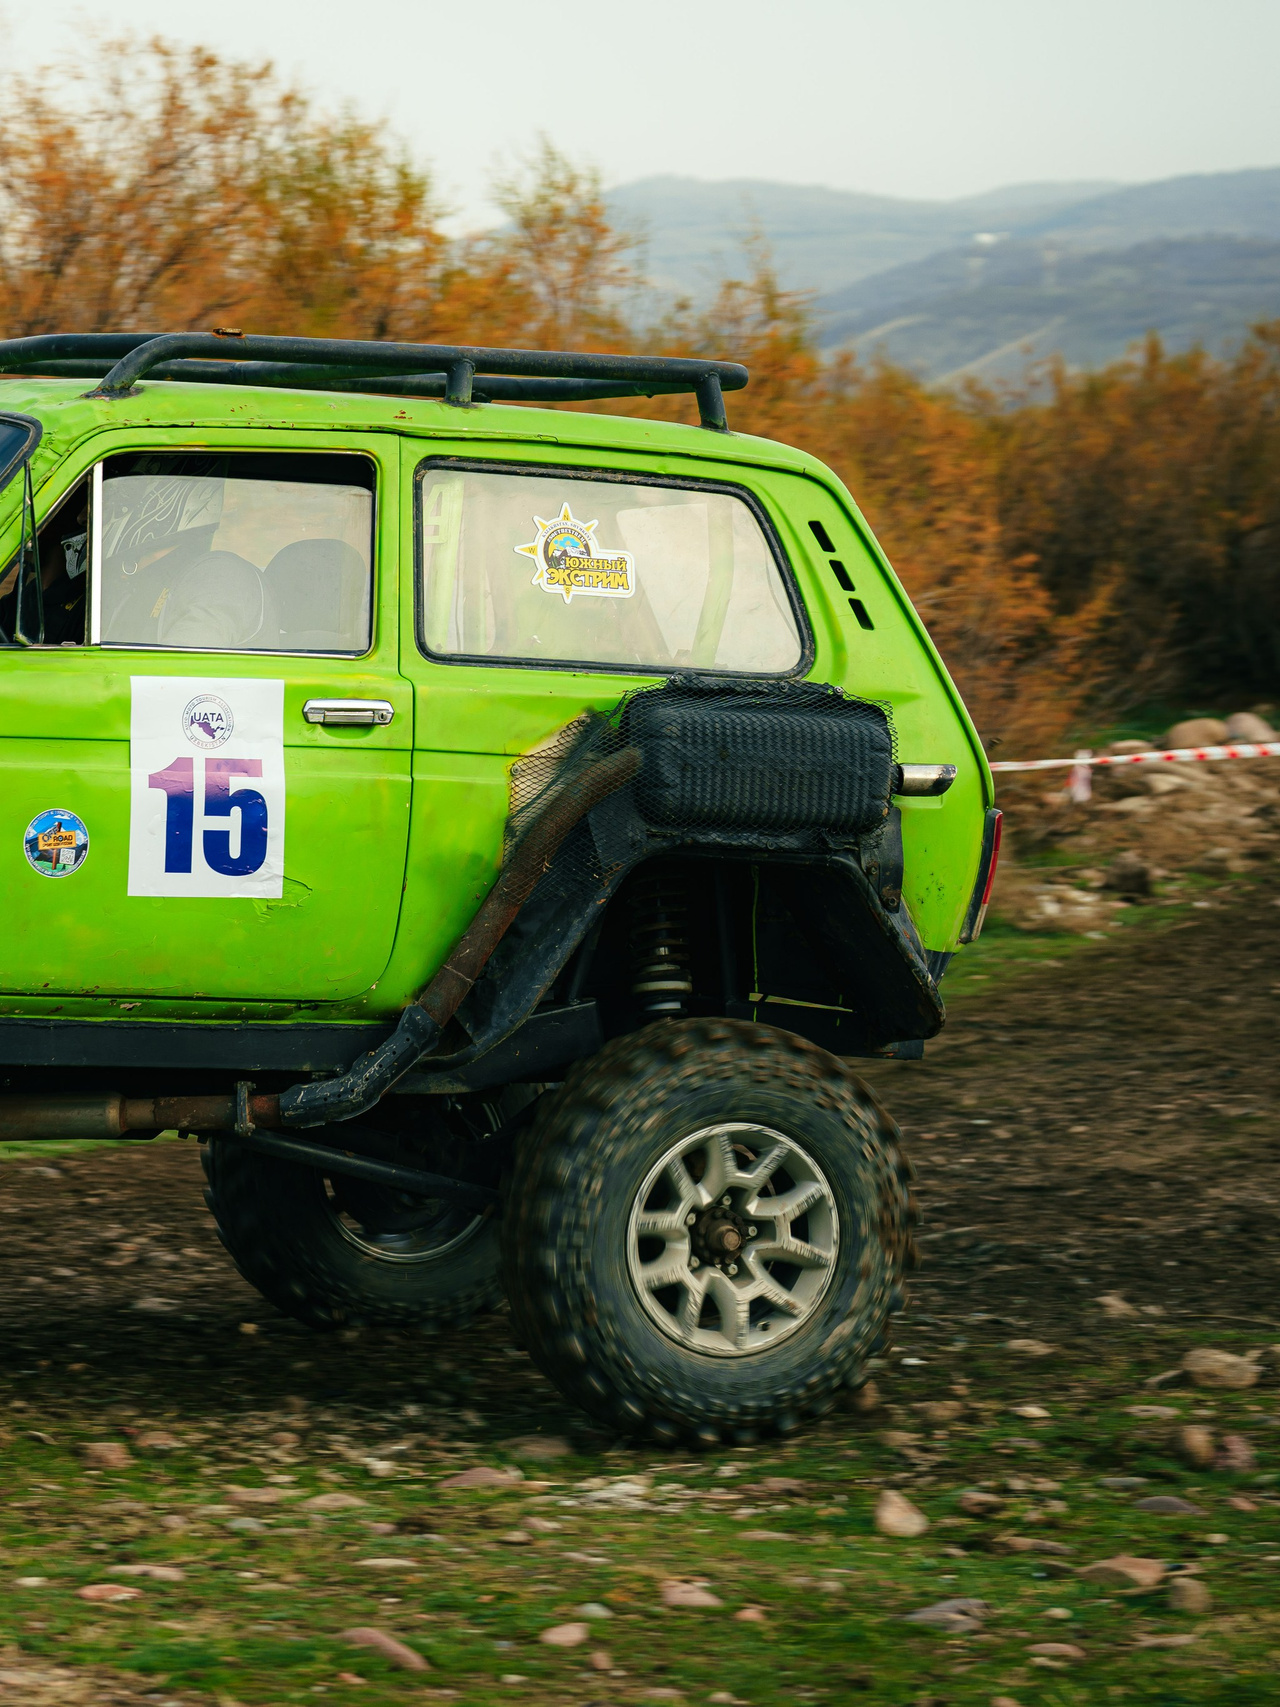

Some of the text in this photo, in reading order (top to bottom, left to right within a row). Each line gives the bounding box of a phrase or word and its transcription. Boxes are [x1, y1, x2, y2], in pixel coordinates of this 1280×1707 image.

[565, 557, 627, 572] ЮЖНЫЙ
[546, 568, 629, 590] ЭКСТРИМ
[193, 712, 224, 722] UATA
[148, 757, 268, 877] 15
[53, 834, 73, 842] ROAD
